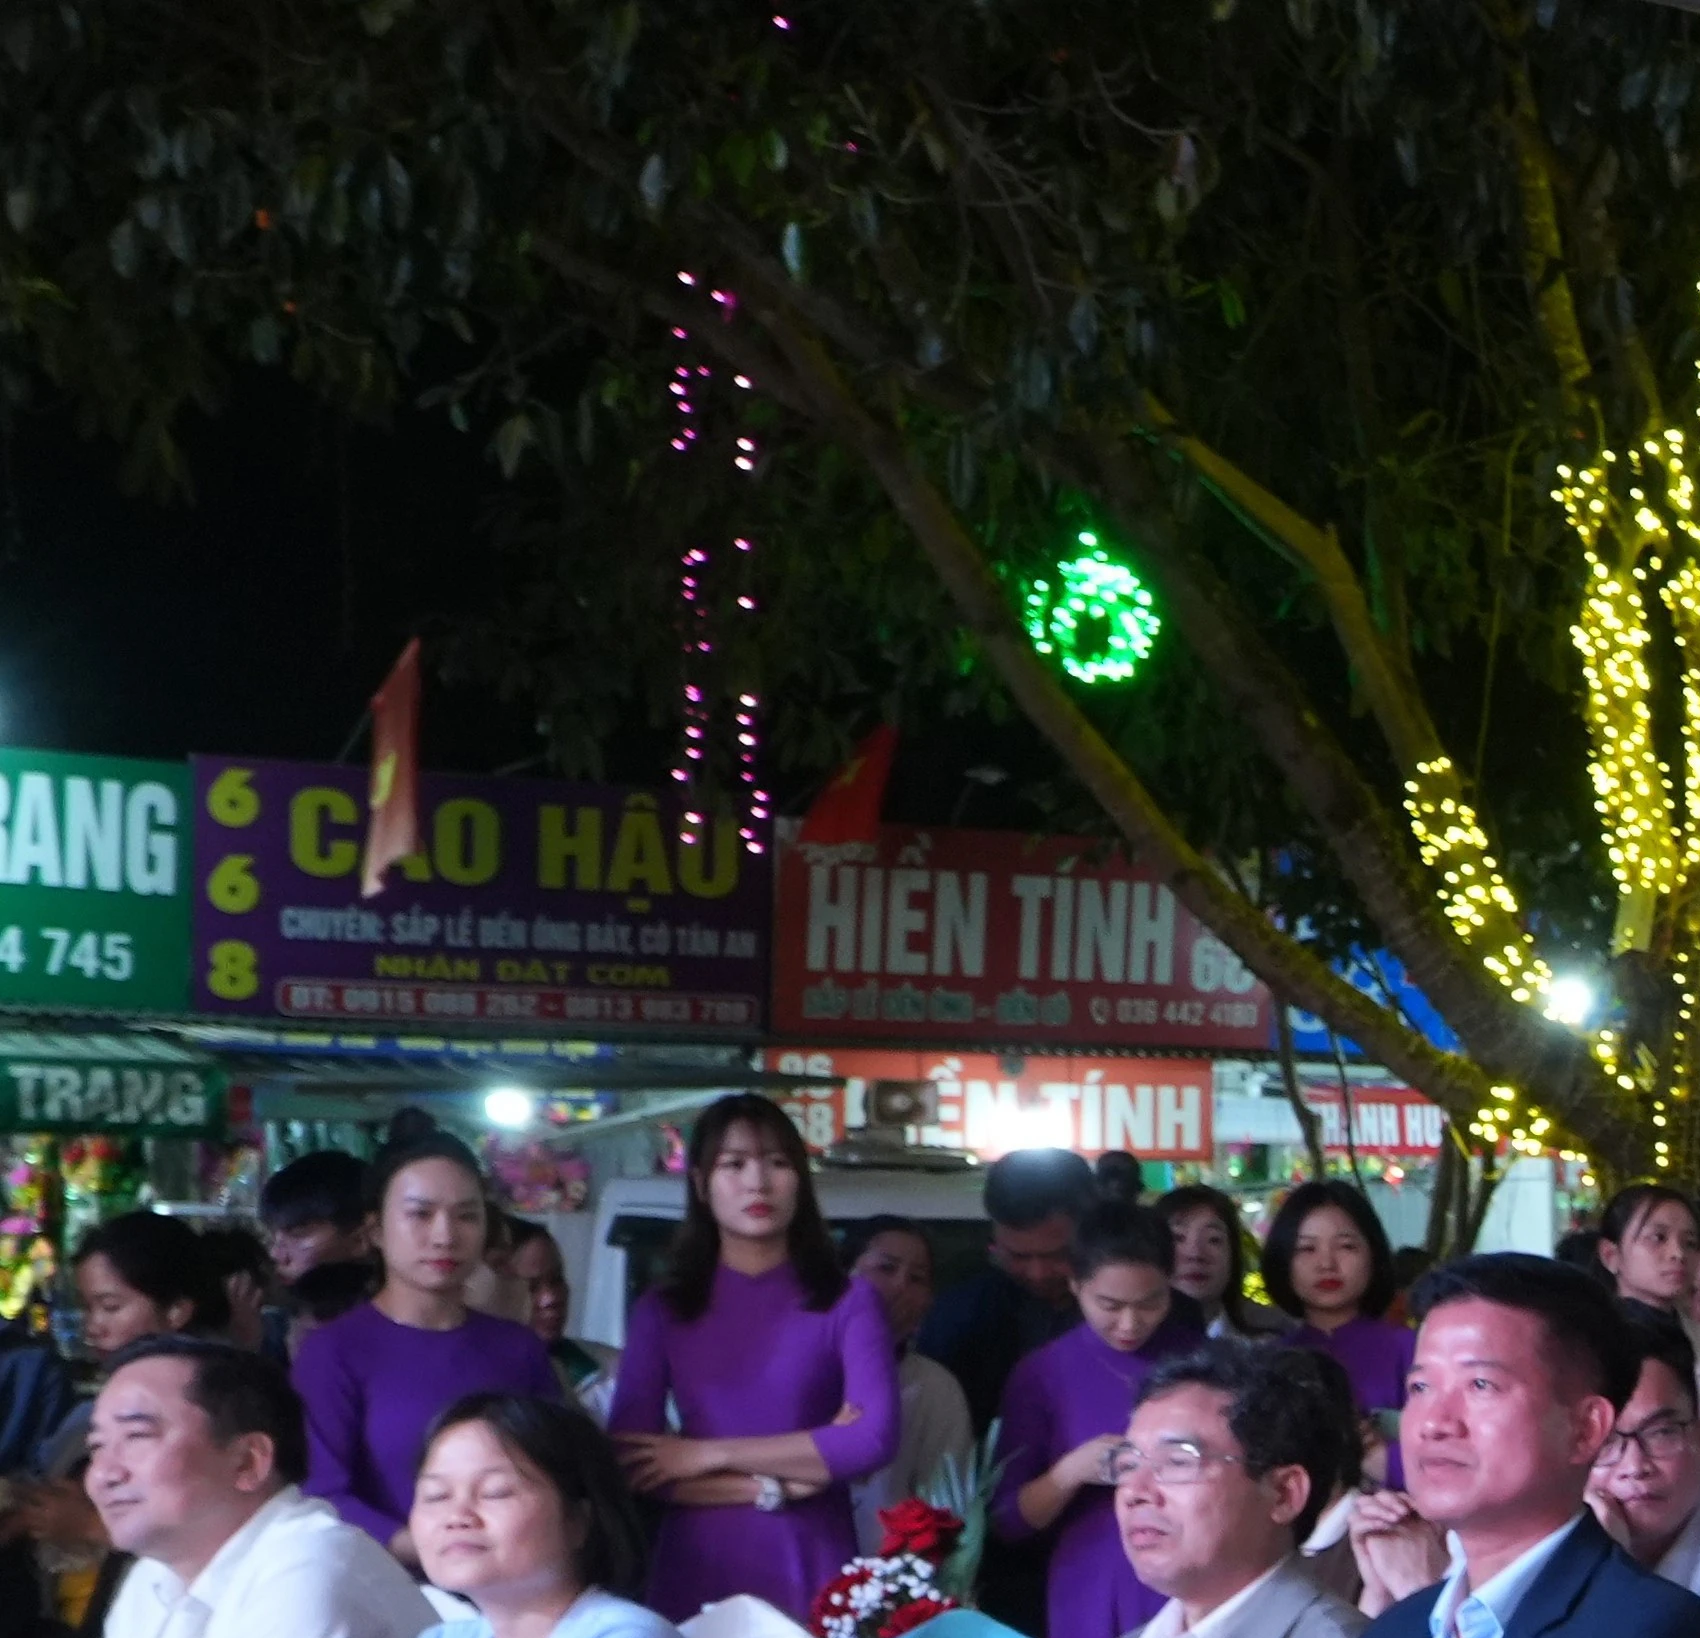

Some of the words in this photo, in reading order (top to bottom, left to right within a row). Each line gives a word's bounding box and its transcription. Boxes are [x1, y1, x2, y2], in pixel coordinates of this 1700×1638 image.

[0, 771, 178, 896] ANG
[289, 786, 500, 887] CO
[538, 793, 740, 913] HẬU
[41, 928, 133, 981] 745
[806, 838, 988, 977] HIỀN
[1012, 855, 1176, 984] TÍNH
[7, 1062, 207, 1125] TRANG
